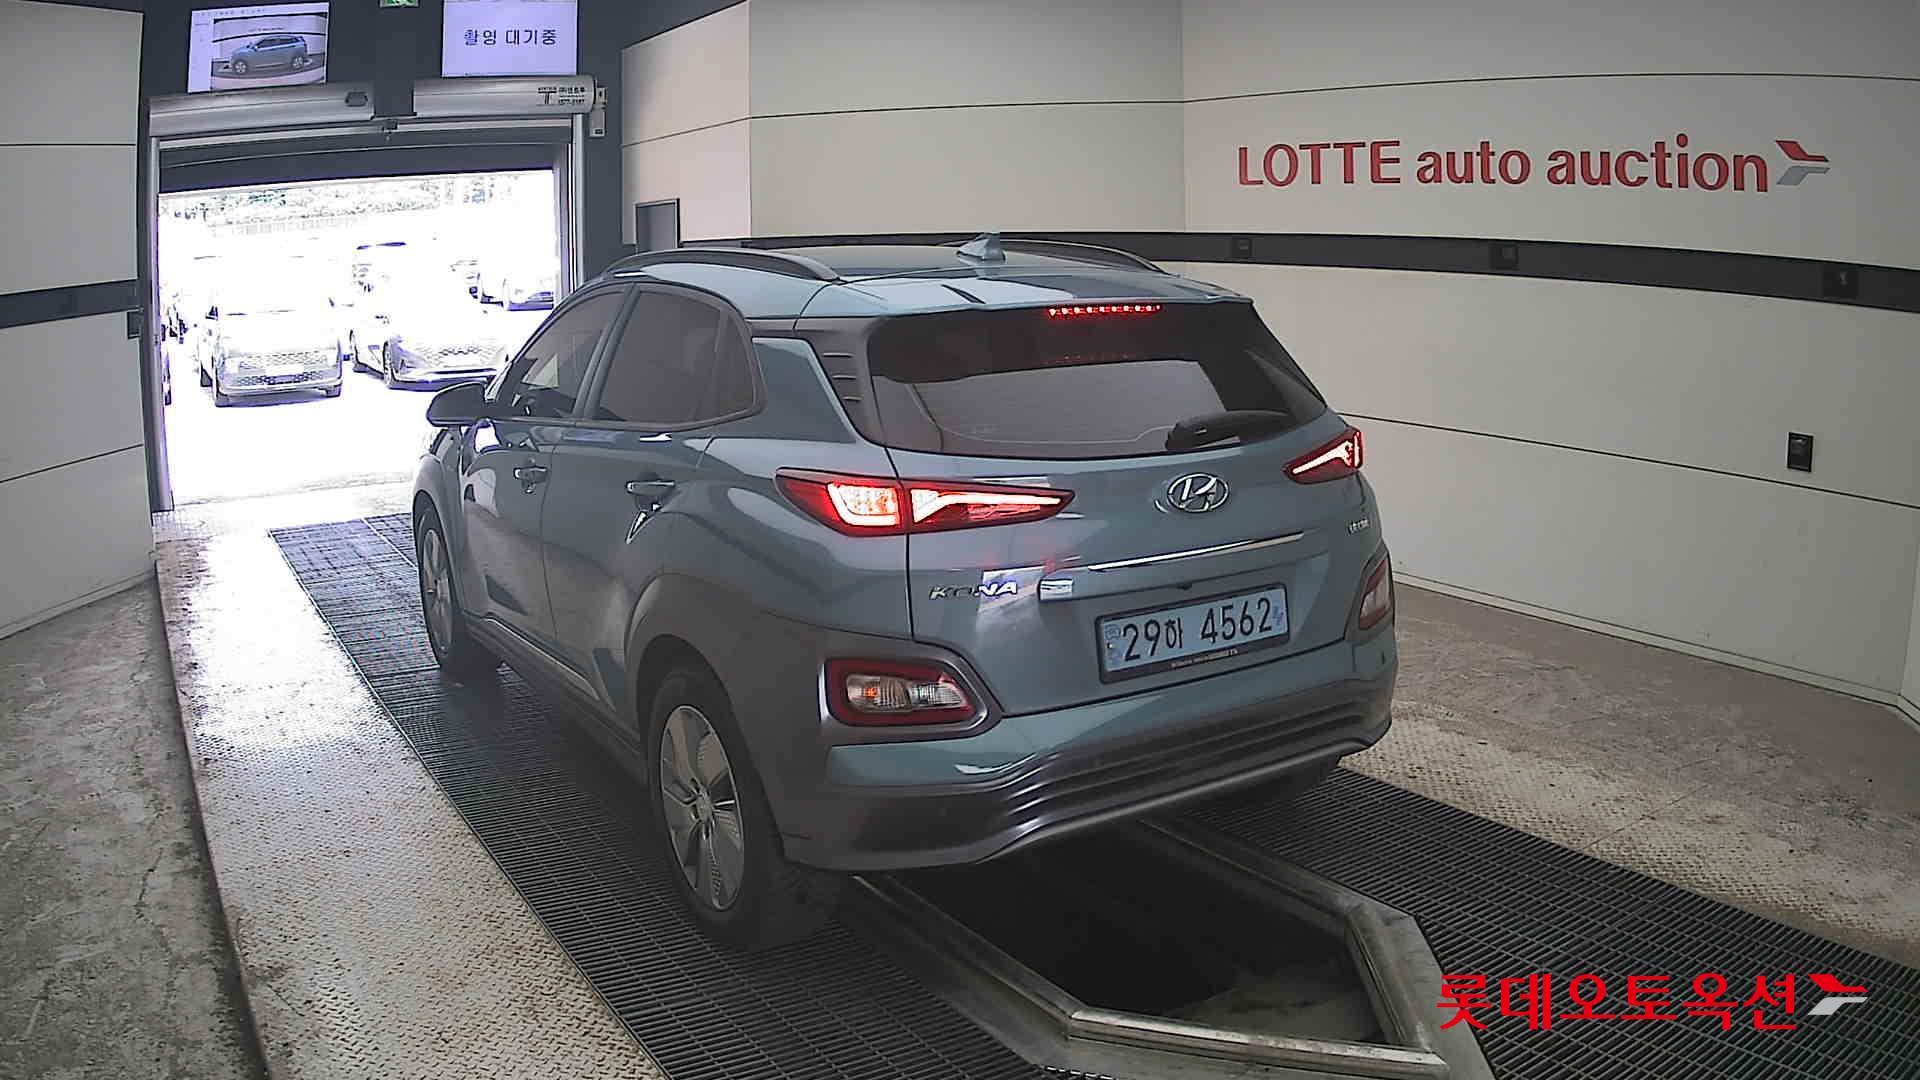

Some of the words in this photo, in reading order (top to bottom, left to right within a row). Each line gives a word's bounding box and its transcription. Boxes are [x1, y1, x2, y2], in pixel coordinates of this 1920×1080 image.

[505, 29, 557, 46] 대기중
[1238, 140, 1401, 187] LOTTE
[1416, 141, 1531, 186] auto
[1546, 133, 1769, 193] auction
[1122, 617, 1184, 662] 29하
[1200, 597, 1273, 644] 4562
